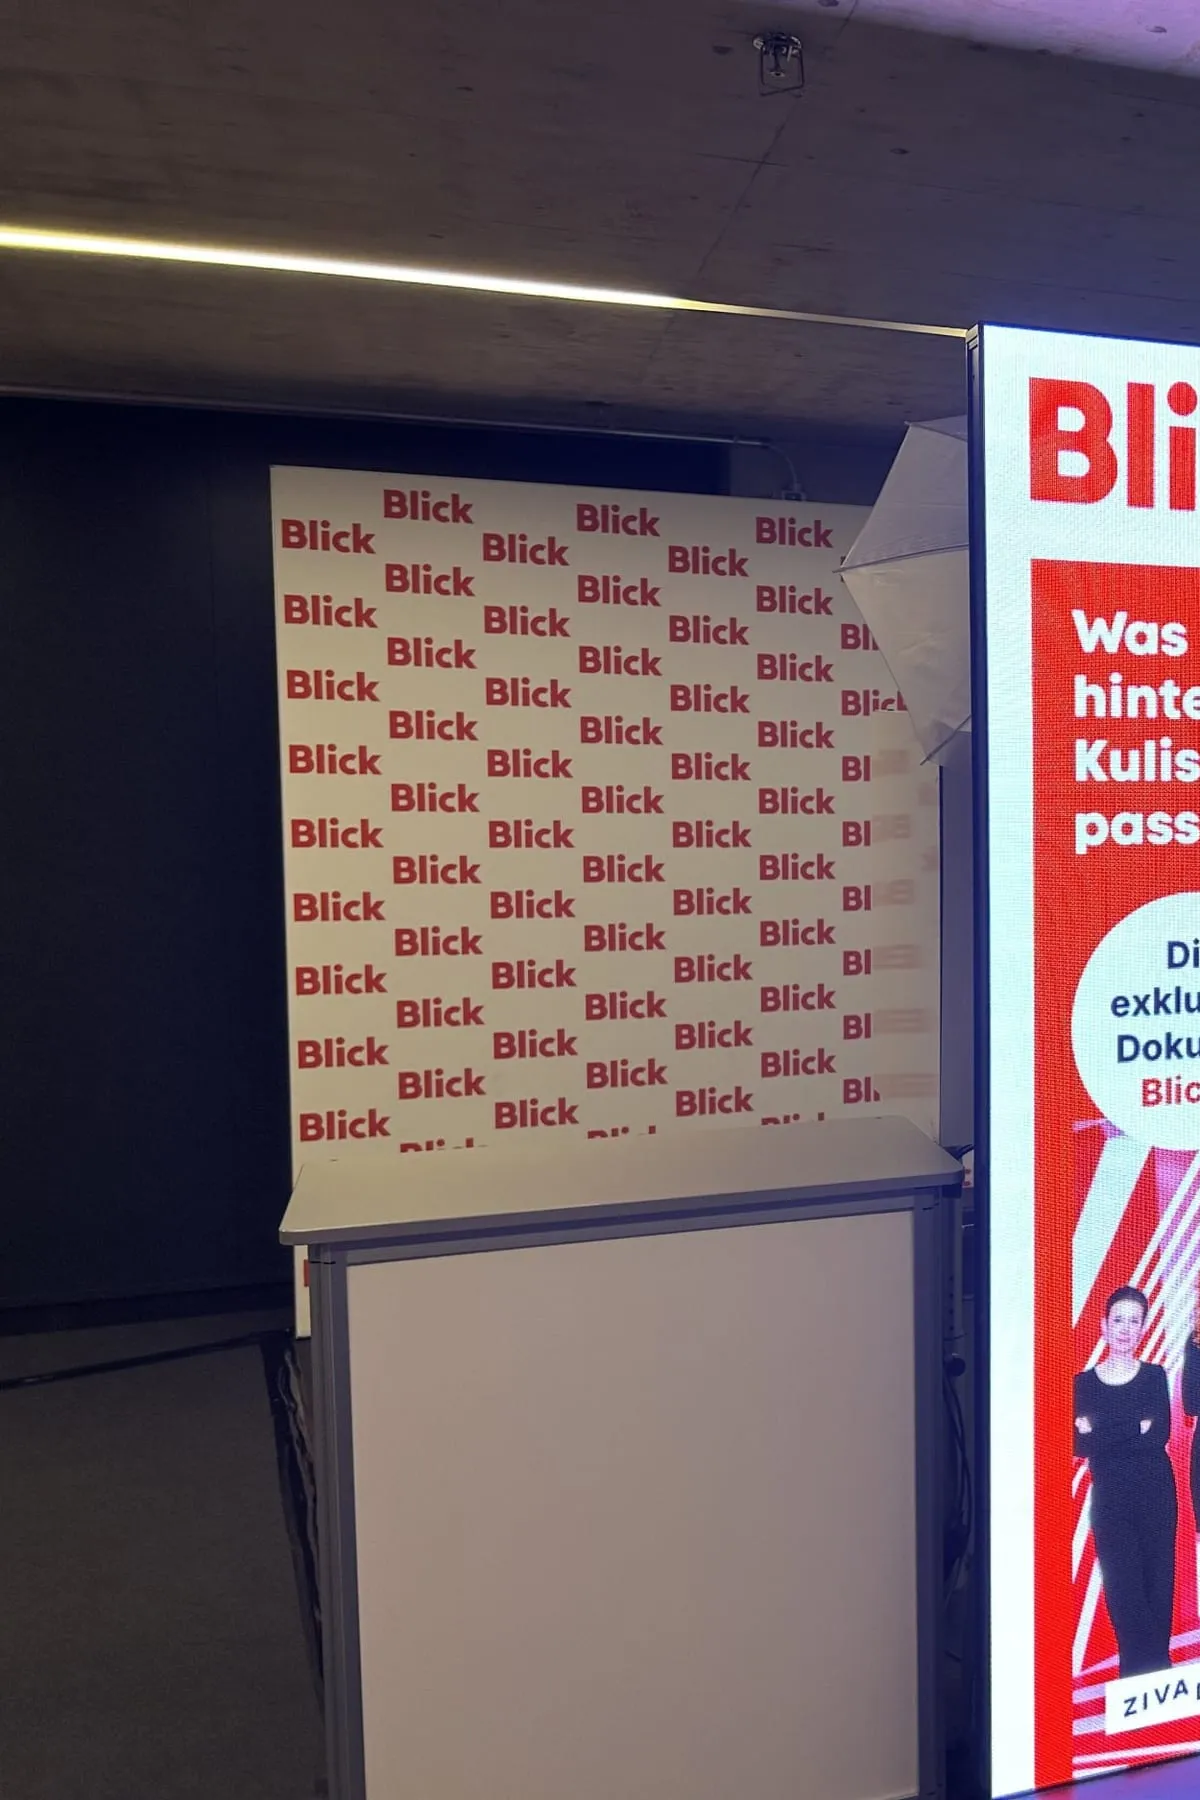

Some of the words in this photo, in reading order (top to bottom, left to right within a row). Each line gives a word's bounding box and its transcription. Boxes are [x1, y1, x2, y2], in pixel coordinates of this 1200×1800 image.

[383, 489, 472, 524] Blick
[577, 503, 658, 534] Blick
[280, 518, 375, 555] Blick
[756, 517, 831, 546] Blick
[481, 531, 568, 567] Blick
[668, 545, 747, 576] Blick
[384, 562, 474, 598] Blick
[577, 574, 660, 607] Blick
[282, 592, 378, 629] Blick
[755, 585, 831, 614] Blick
[482, 604, 571, 638] Blick
[668, 614, 751, 646] Blick
[1071, 608, 1189, 657] Was
[385, 635, 479, 670] Blick
[578, 644, 662, 677] Blick
[756, 652, 832, 683] Blick
[284, 667, 380, 704] Blick
[484, 675, 574, 709] Blick
[669, 683, 750, 715] Blick
[387, 708, 478, 743] Blick
[578, 714, 663, 746] Blick
[756, 719, 834, 750] Blick
[287, 743, 383, 777] Blick
[485, 746, 573, 780] Blick
[670, 751, 751, 782] Blick
[389, 781, 480, 814] Blick
[579, 784, 664, 815] Blick
[757, 786, 835, 815] Blick
[288, 816, 384, 851] Blick
[487, 818, 575, 850] Blick
[671, 819, 752, 849] Blick
[391, 853, 483, 886] Blick
[581, 852, 665, 884] Blick
[758, 853, 834, 881] Blick
[291, 889, 387, 924] Blick
[489, 888, 577, 921] Blick
[671, 887, 752, 917] Blick
[392, 925, 484, 958] Blick
[582, 922, 666, 953] Blick
[759, 918, 834, 947] Blick
[293, 962, 389, 997] Blick
[490, 958, 577, 991] Blick
[673, 953, 751, 984] Blick
[395, 996, 486, 1030] Blick
[584, 990, 667, 1022] Blick
[759, 983, 835, 1014] Blick
[491, 1027, 579, 1061] Blick
[674, 1020, 753, 1051] Blick
[296, 1035, 390, 1071] Blick
[760, 1048, 835, 1079] Blick
[396, 1067, 485, 1101] Blick
[585, 1057, 668, 1090] Blick
[493, 1097, 579, 1131] Blick
[674, 1086, 752, 1117] Blick
[297, 1108, 390, 1143] Blick
